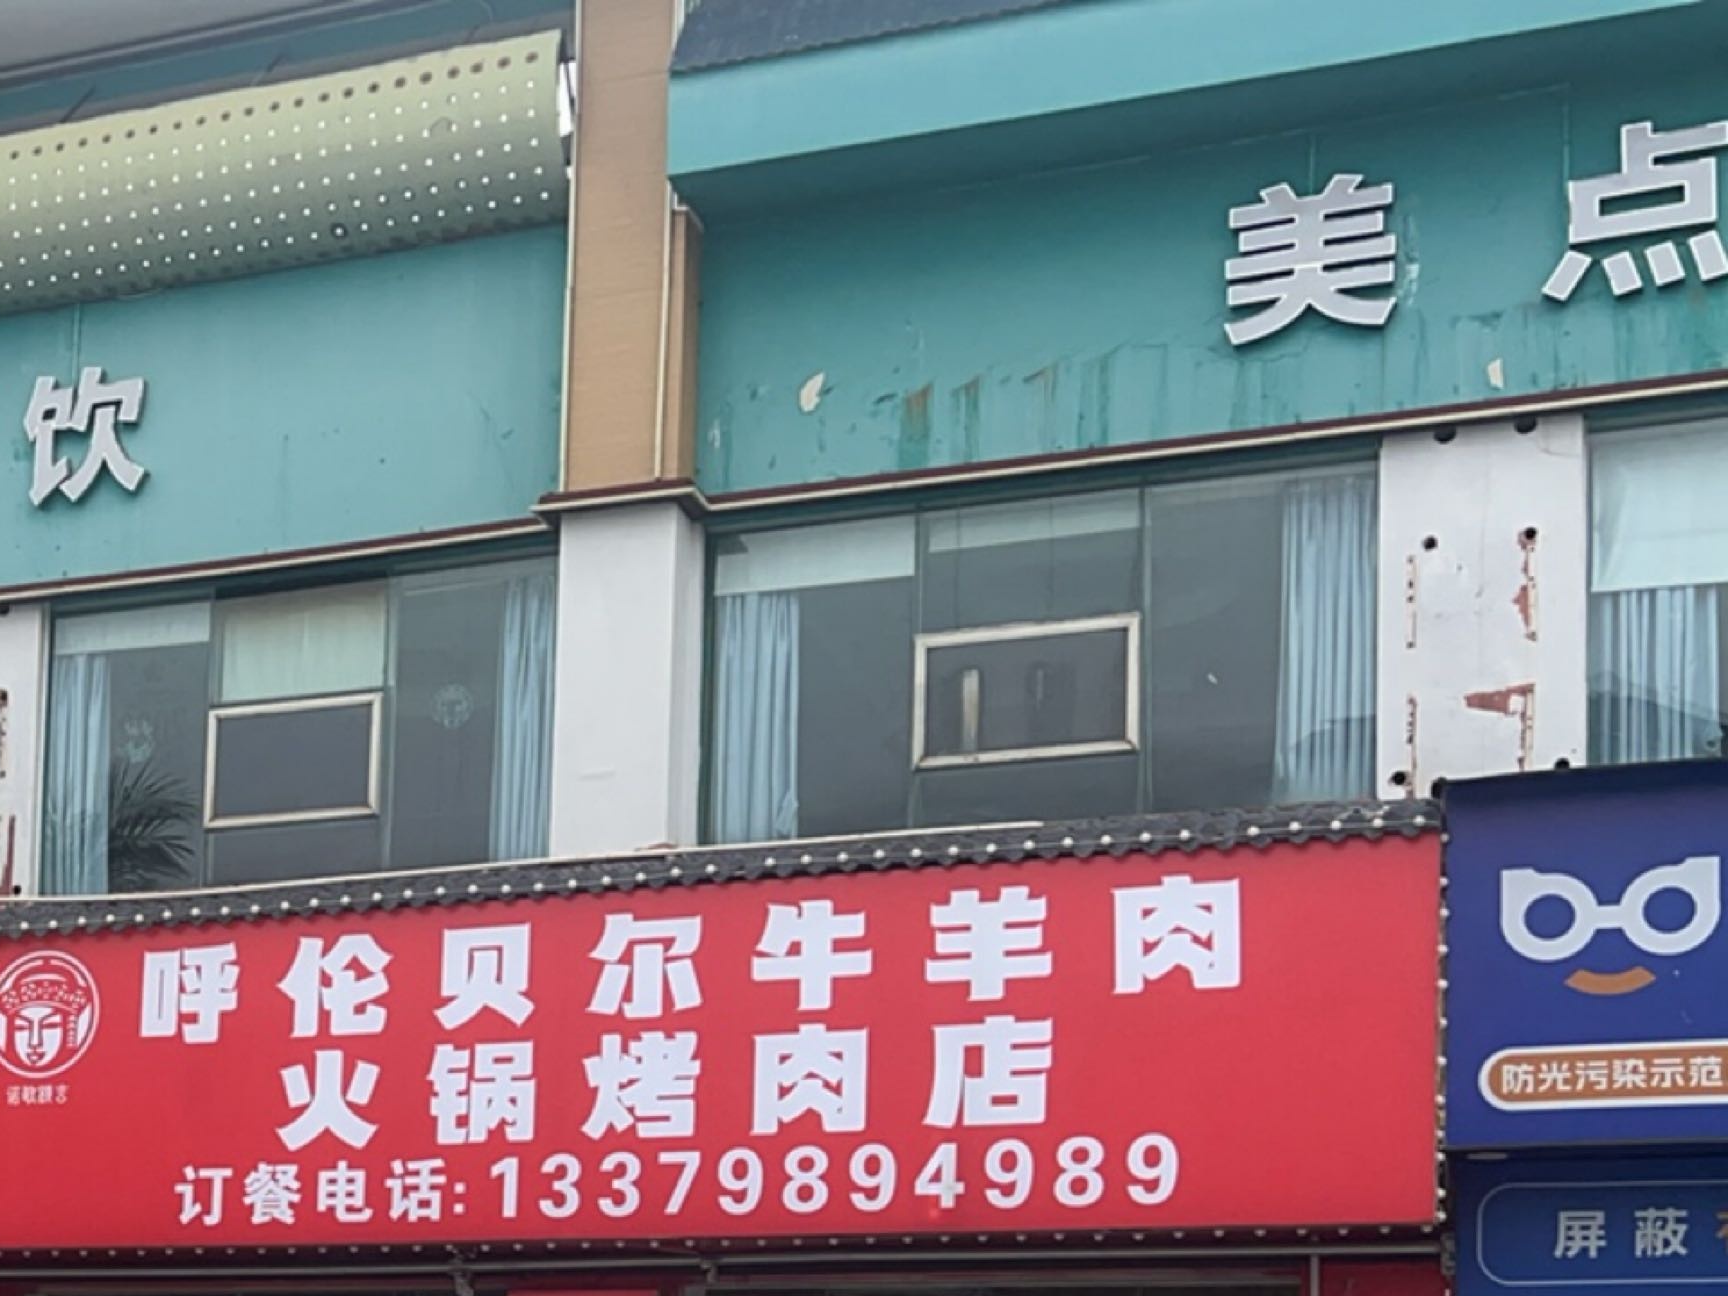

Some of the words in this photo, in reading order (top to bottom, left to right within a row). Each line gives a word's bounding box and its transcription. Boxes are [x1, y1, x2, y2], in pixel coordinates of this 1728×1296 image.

[1224, 121, 1728, 345] 美点
[140, 875, 1240, 1044] 呼伦贝尔牛羊肉
[276, 1015, 1053, 1151] 火锅烤肉店
[1502, 1056, 1723, 1094] 防光污染示范
[1555, 1207, 1728, 1259] 屏蔽
